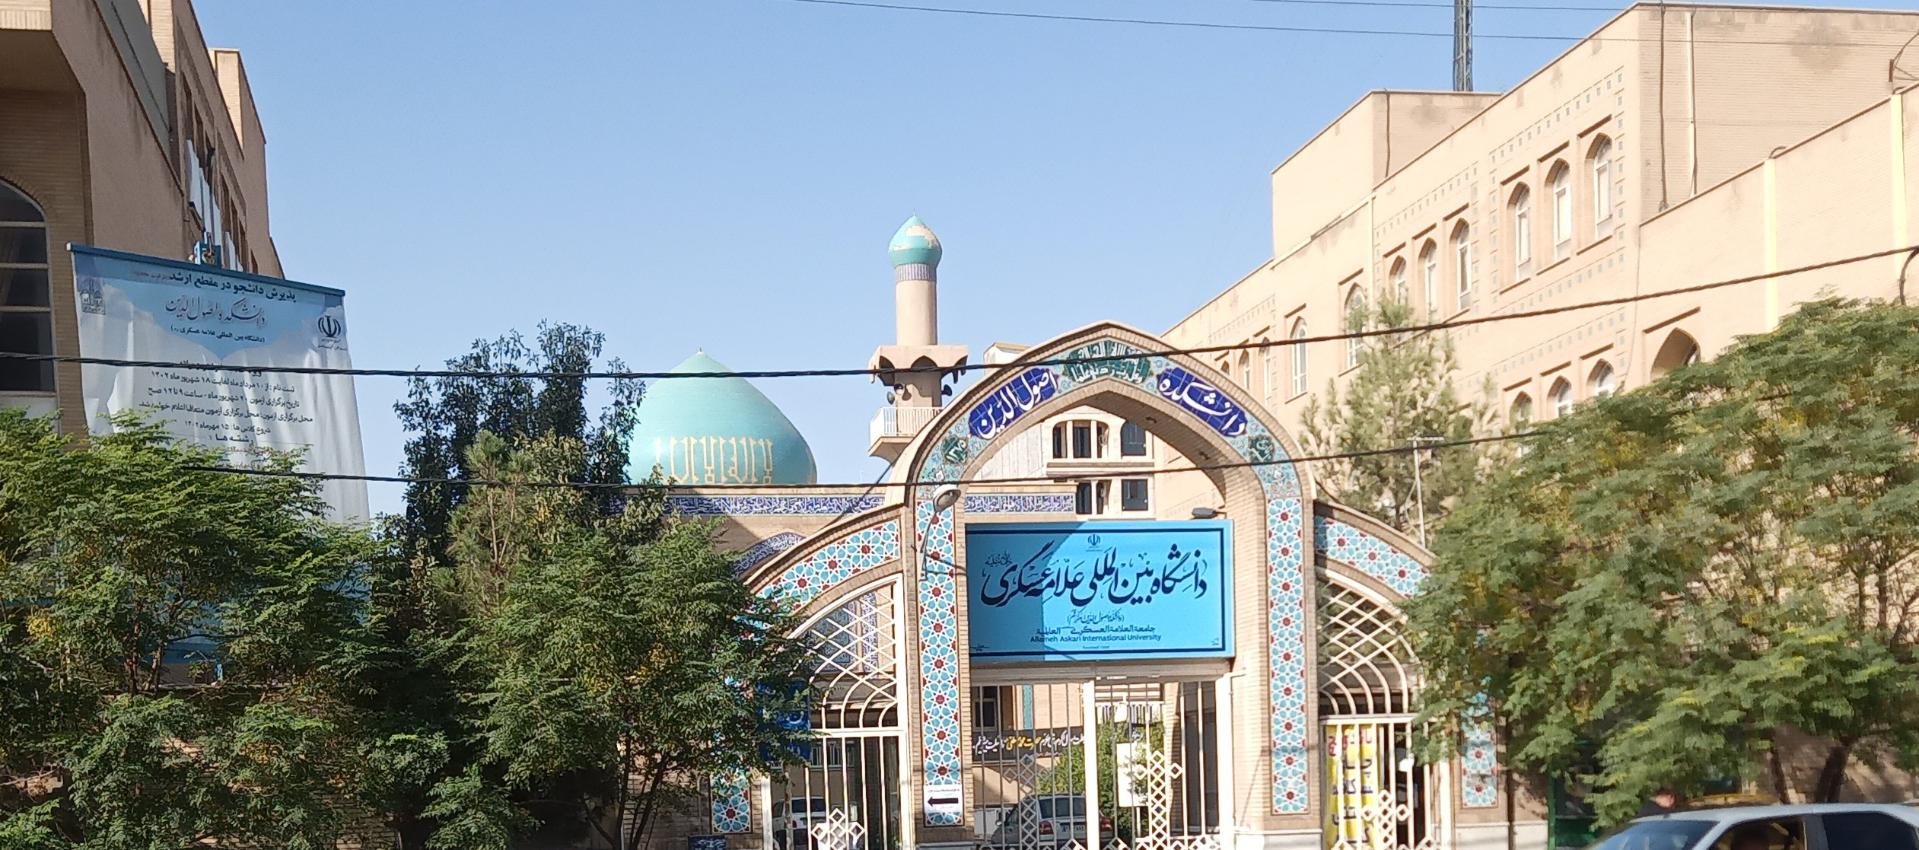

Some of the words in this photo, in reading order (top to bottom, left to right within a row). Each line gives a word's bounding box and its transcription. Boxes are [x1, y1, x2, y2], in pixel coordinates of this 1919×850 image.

[169, 271, 192, 285] ارشد
[194, 276, 218, 289] مقطع
[221, 282, 231, 290] در
[233, 283, 264, 295] دانشجو
[266, 288, 296, 302] پذیرش
[1017, 371, 1057, 411] اصول
[976, 385, 1018, 440] الدین
[1159, 378, 1246, 435] دانشکده
[980, 540, 1056, 608] عسکری
[1149, 543, 1208, 600] دانشگاه
[1082, 634, 1126, 642] International
[1127, 632, 1161, 642] University
